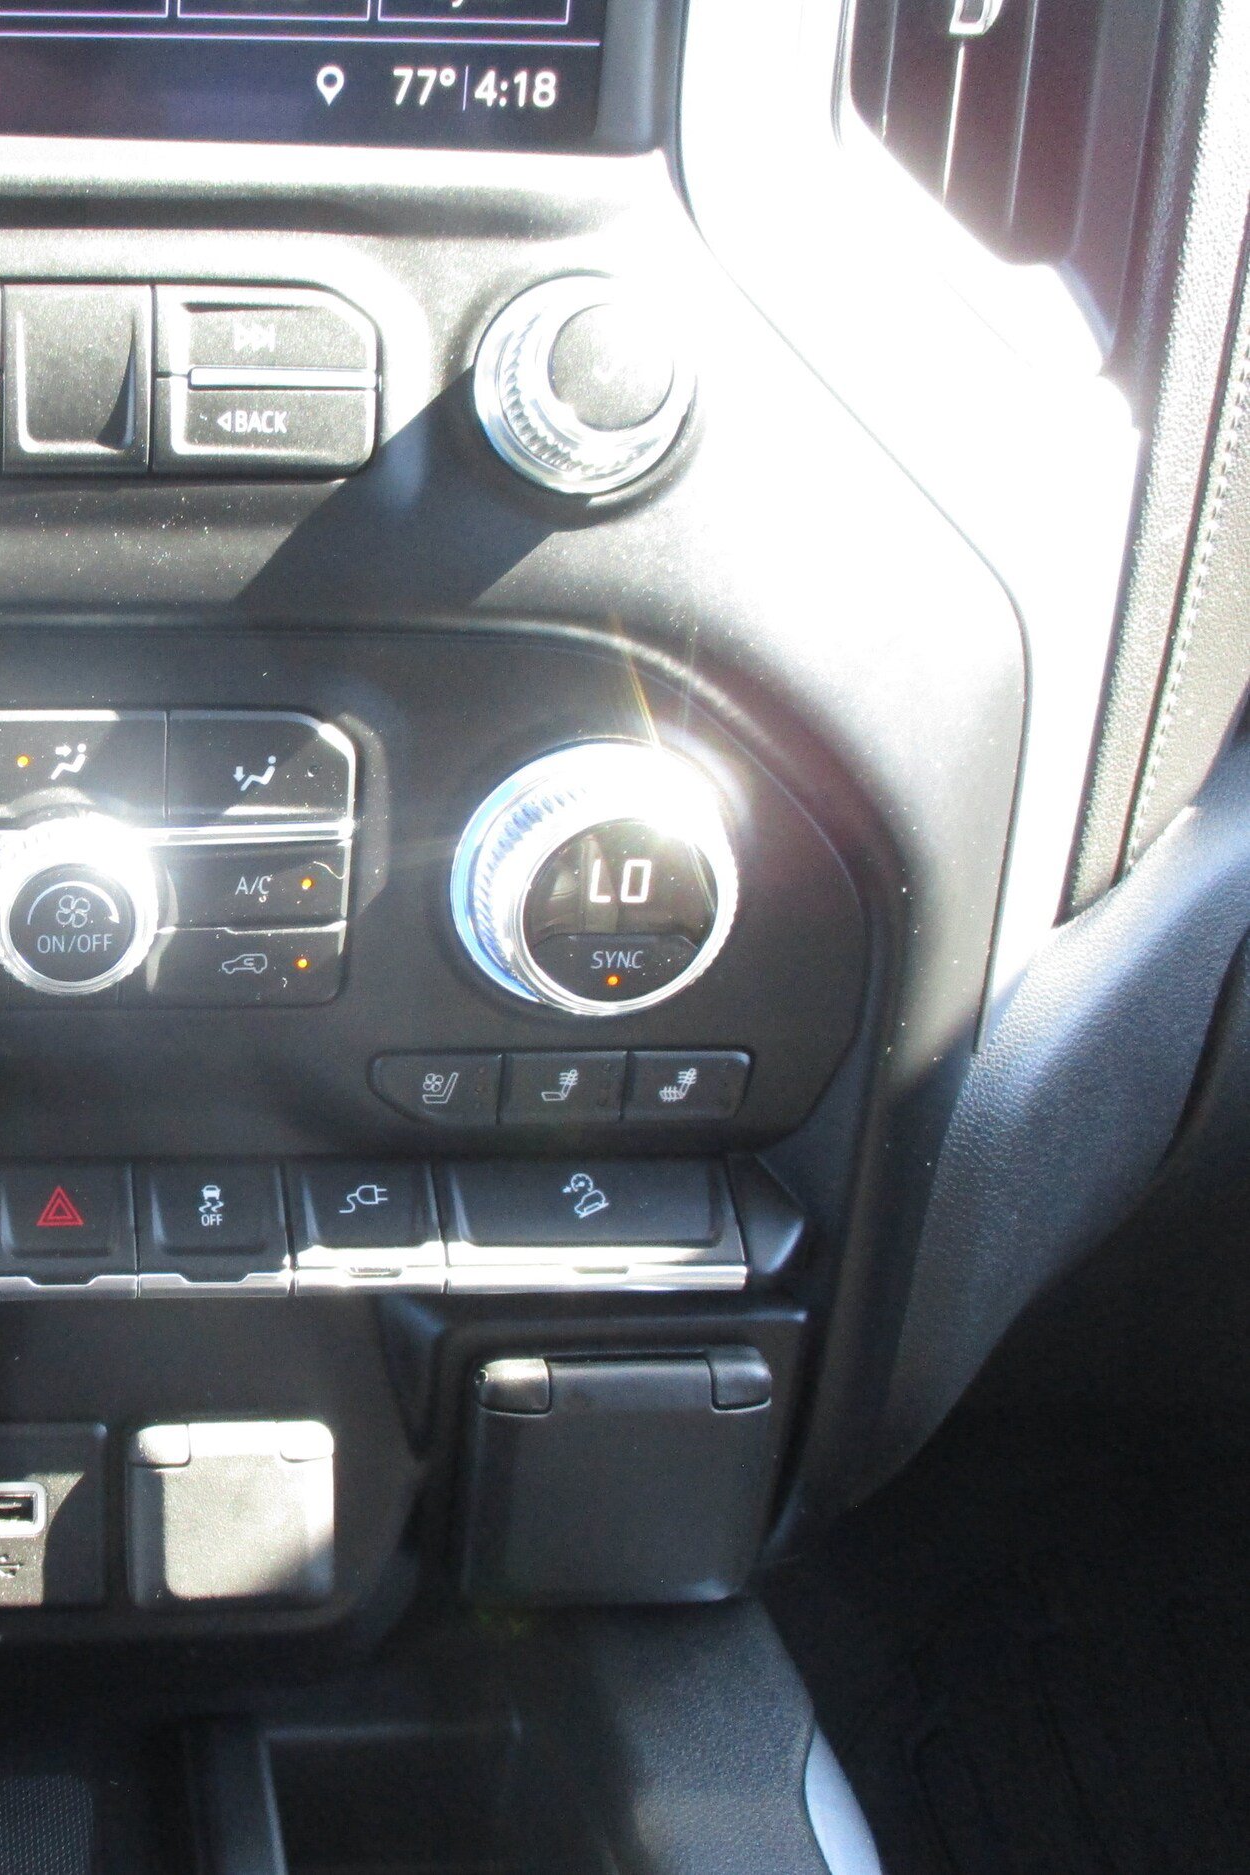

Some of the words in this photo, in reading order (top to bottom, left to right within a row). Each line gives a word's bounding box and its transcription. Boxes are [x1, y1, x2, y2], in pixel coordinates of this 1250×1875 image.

[392, 67, 456, 107] 77°
[474, 69, 557, 108] 4:18
[235, 409, 288, 434] BACK
[235, 875, 271, 896] A/C
[589, 859, 652, 904] LO
[37, 933, 113, 954] ON/OFF
[590, 950, 644, 969] SYNC
[201, 1213, 223, 1227] OFF
